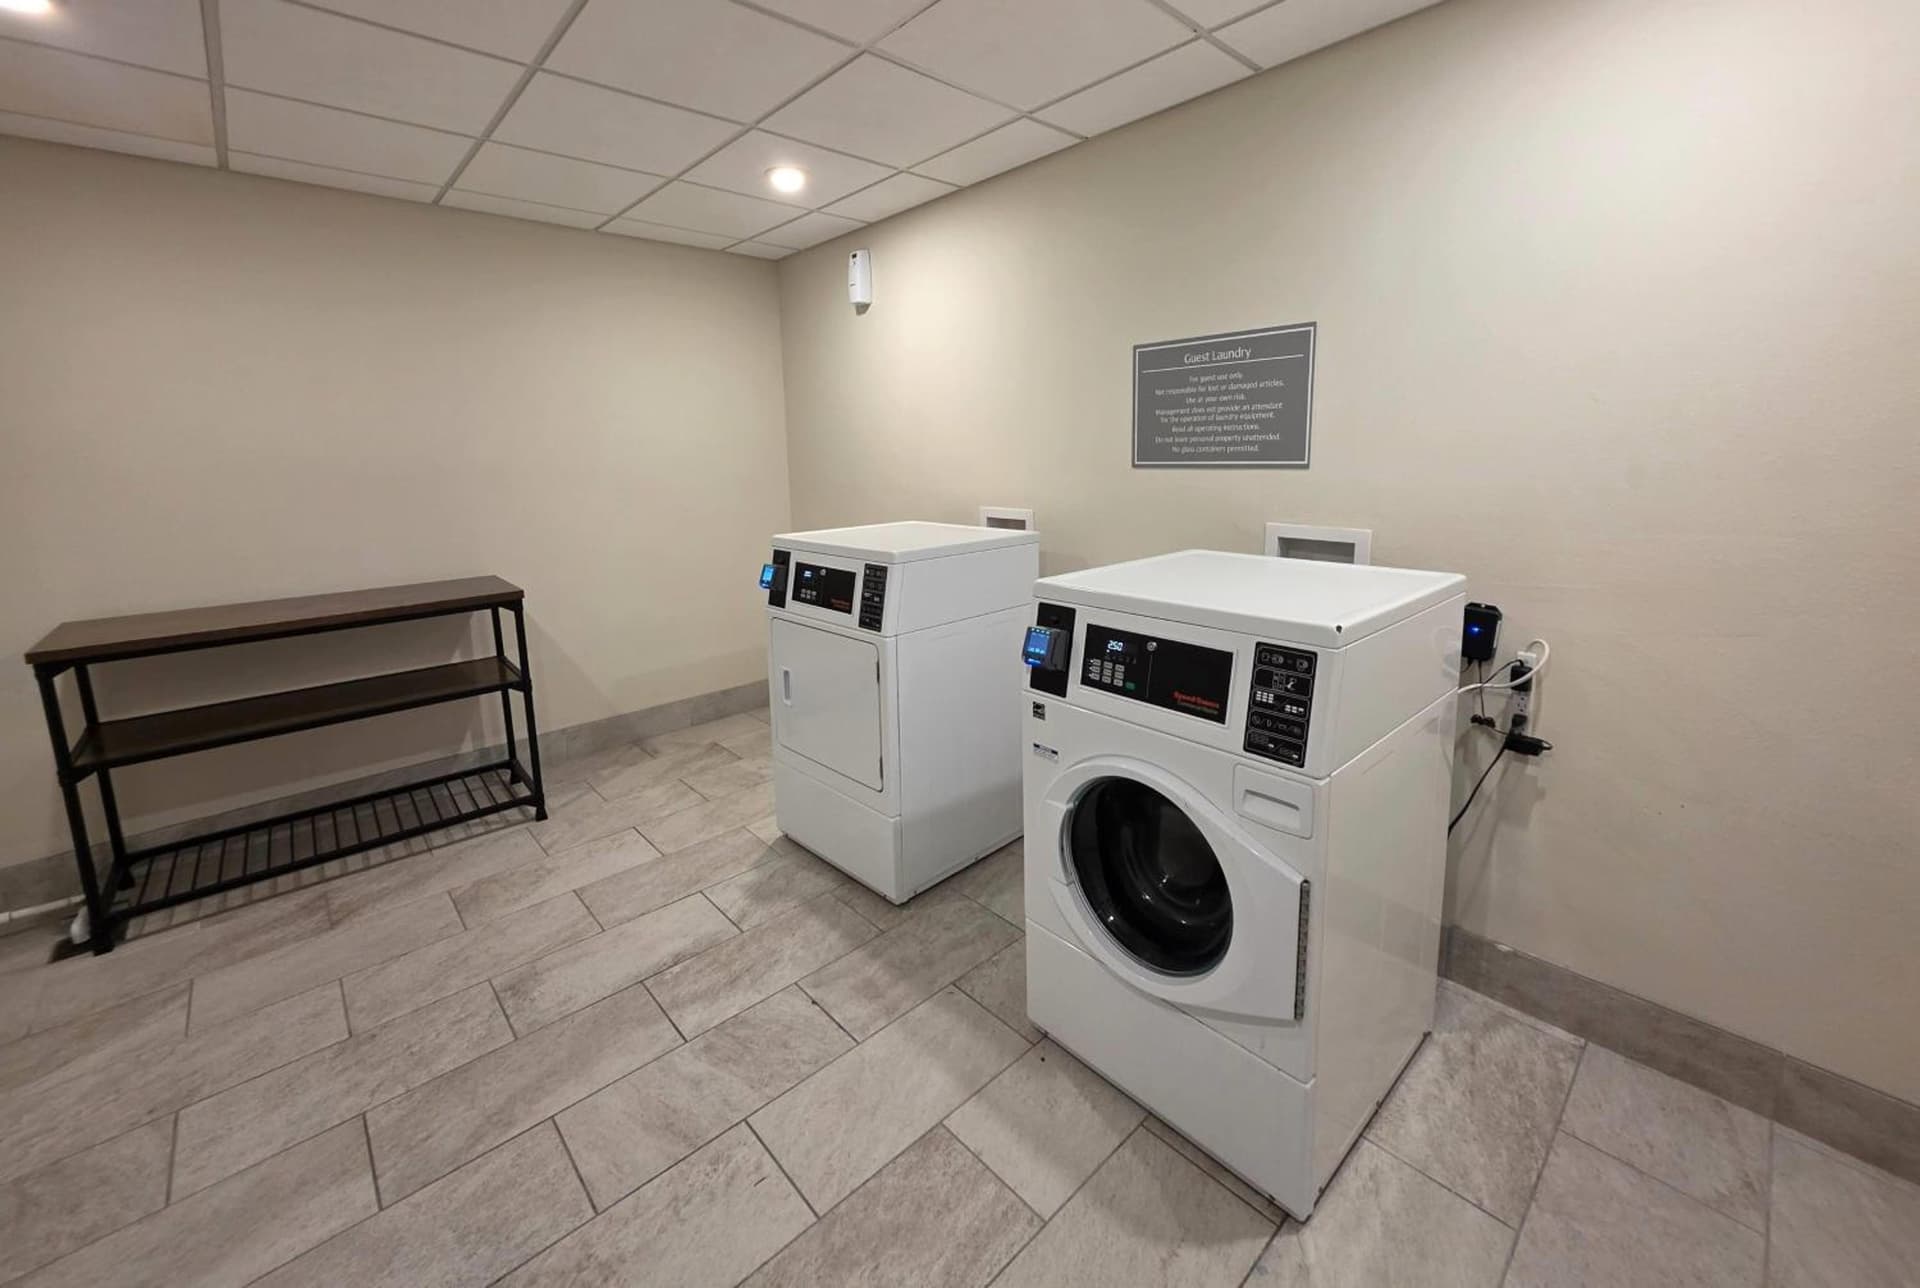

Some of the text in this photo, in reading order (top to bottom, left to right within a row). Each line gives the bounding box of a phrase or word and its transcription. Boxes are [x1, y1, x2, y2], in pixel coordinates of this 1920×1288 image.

[1184, 347, 1252, 364] Guest Laundry
[1200, 374, 1216, 384] guest
[1228, 381, 1258, 390] damaged
[1259, 379, 1284, 388] articles.
[1206, 396, 1218, 404] your
[1156, 408, 1190, 416] Management
[1218, 404, 1240, 413] provide
[1251, 402, 1282, 410] attendant
[1180, 415, 1207, 423] operation
[1216, 414, 1238, 422] laundry
[1240, 412, 1276, 420] equipment.
[1172, 424, 1186, 432] Read
[1194, 424, 1222, 433] operating
[1190, 434, 1214, 444] personal
[1226, 444, 1259, 454] permitted.
[1108, 640, 1124, 651] 250
